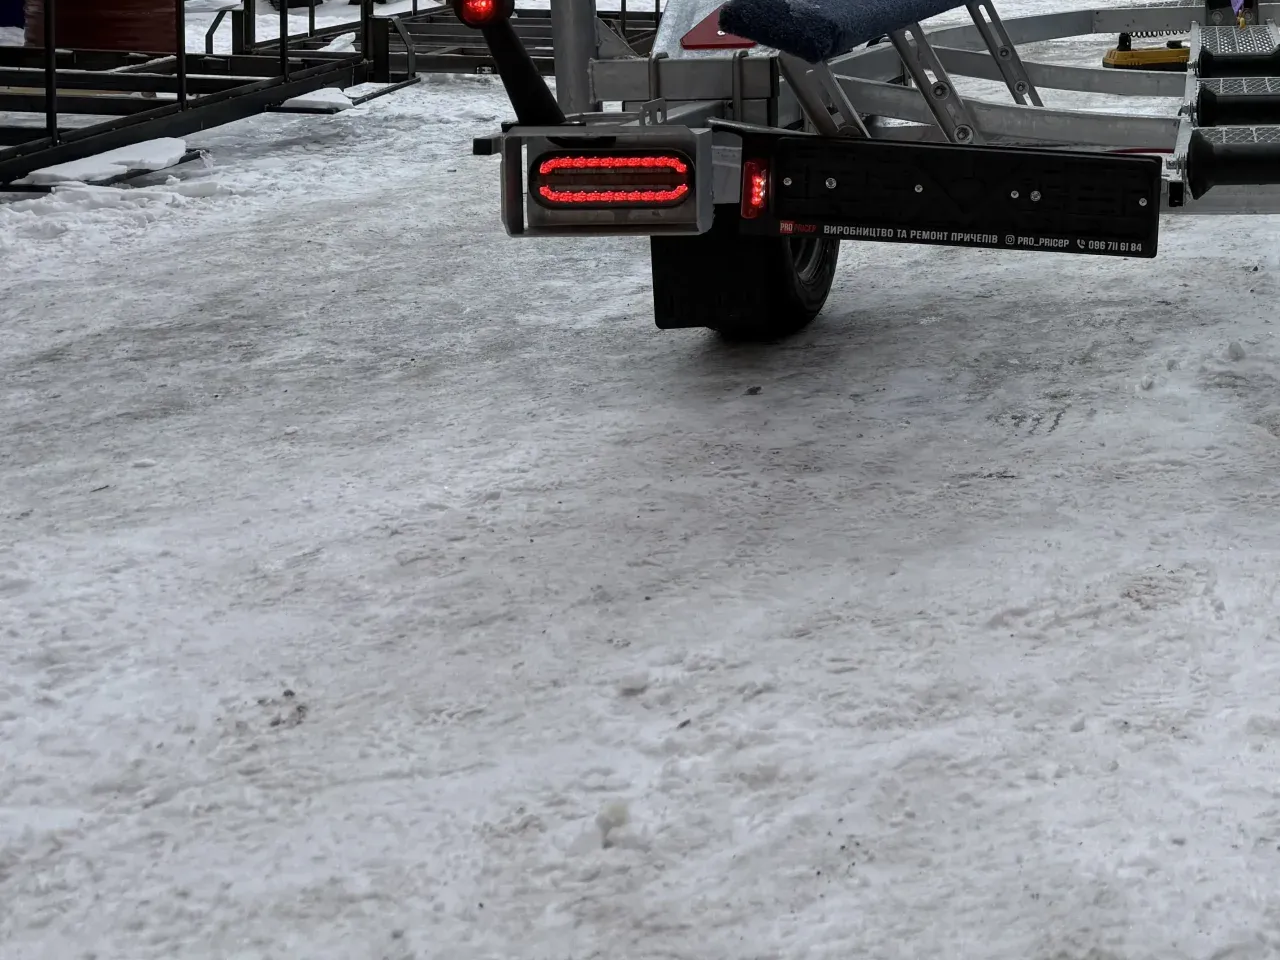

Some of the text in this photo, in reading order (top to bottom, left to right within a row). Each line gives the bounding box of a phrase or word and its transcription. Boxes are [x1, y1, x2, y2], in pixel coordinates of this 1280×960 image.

[780, 223, 793, 233] PRO
[823, 225, 998, 244] ВИРОБНИЦТВО ТА РЕМОНТ ПРИЧЕПІВ
[1088, 240, 1142, 252] 096 711 61 84
